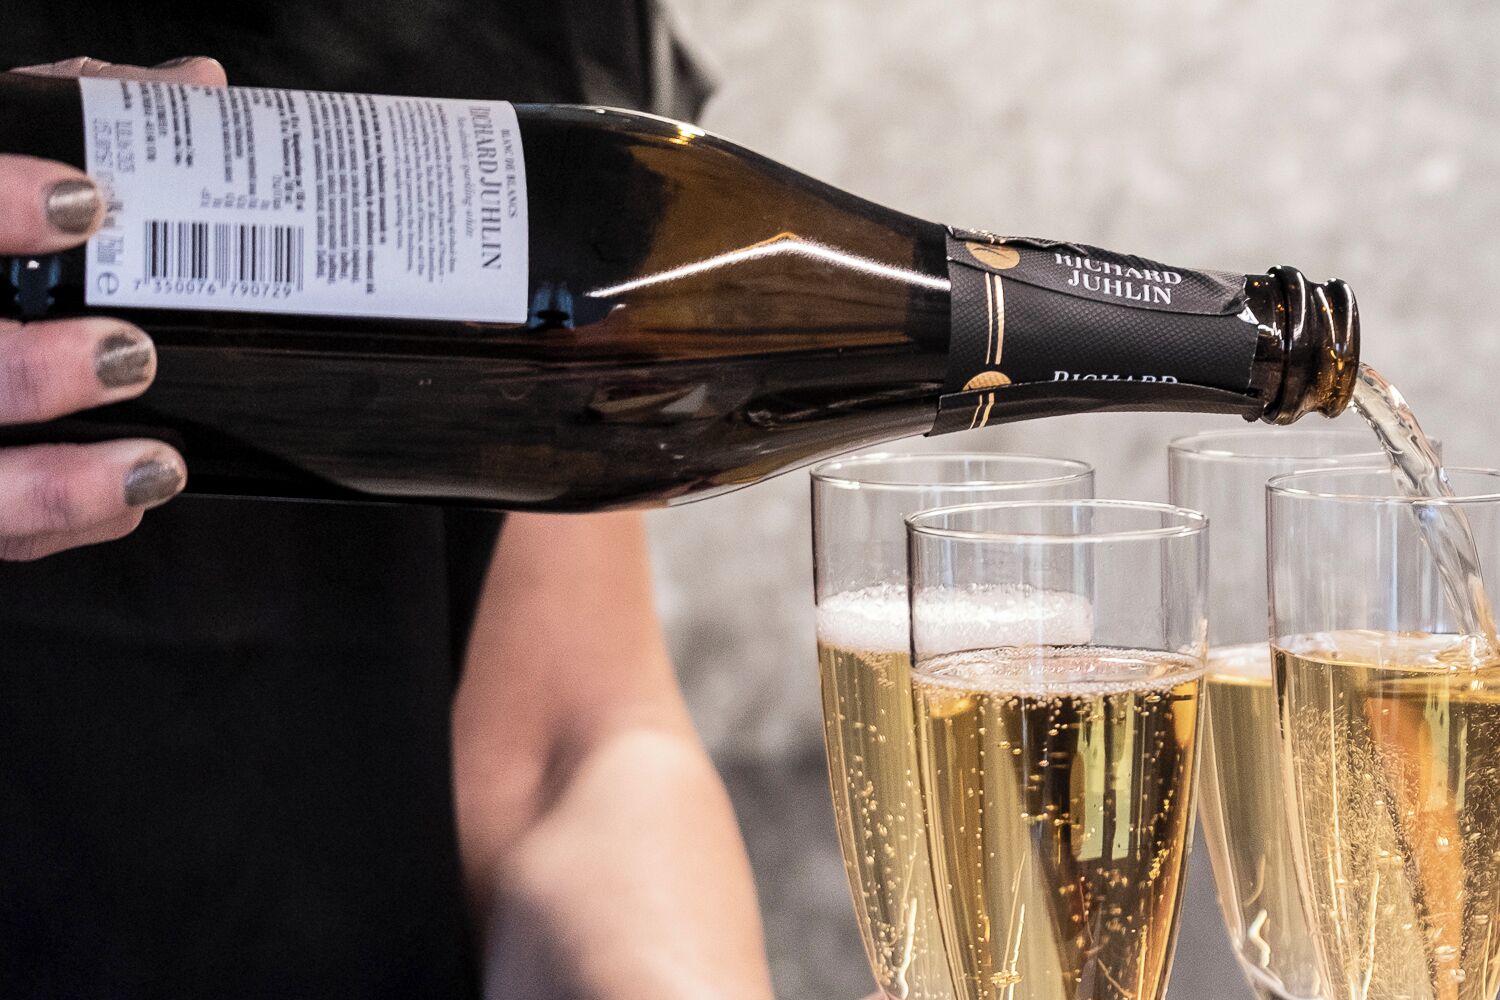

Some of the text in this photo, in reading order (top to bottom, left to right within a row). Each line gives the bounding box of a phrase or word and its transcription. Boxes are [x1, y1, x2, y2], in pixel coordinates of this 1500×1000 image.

[480, 176, 503, 269] JUHLIN
[230, 281, 292, 299] 790729
[1068, 270, 1172, 304] JUHLIN
